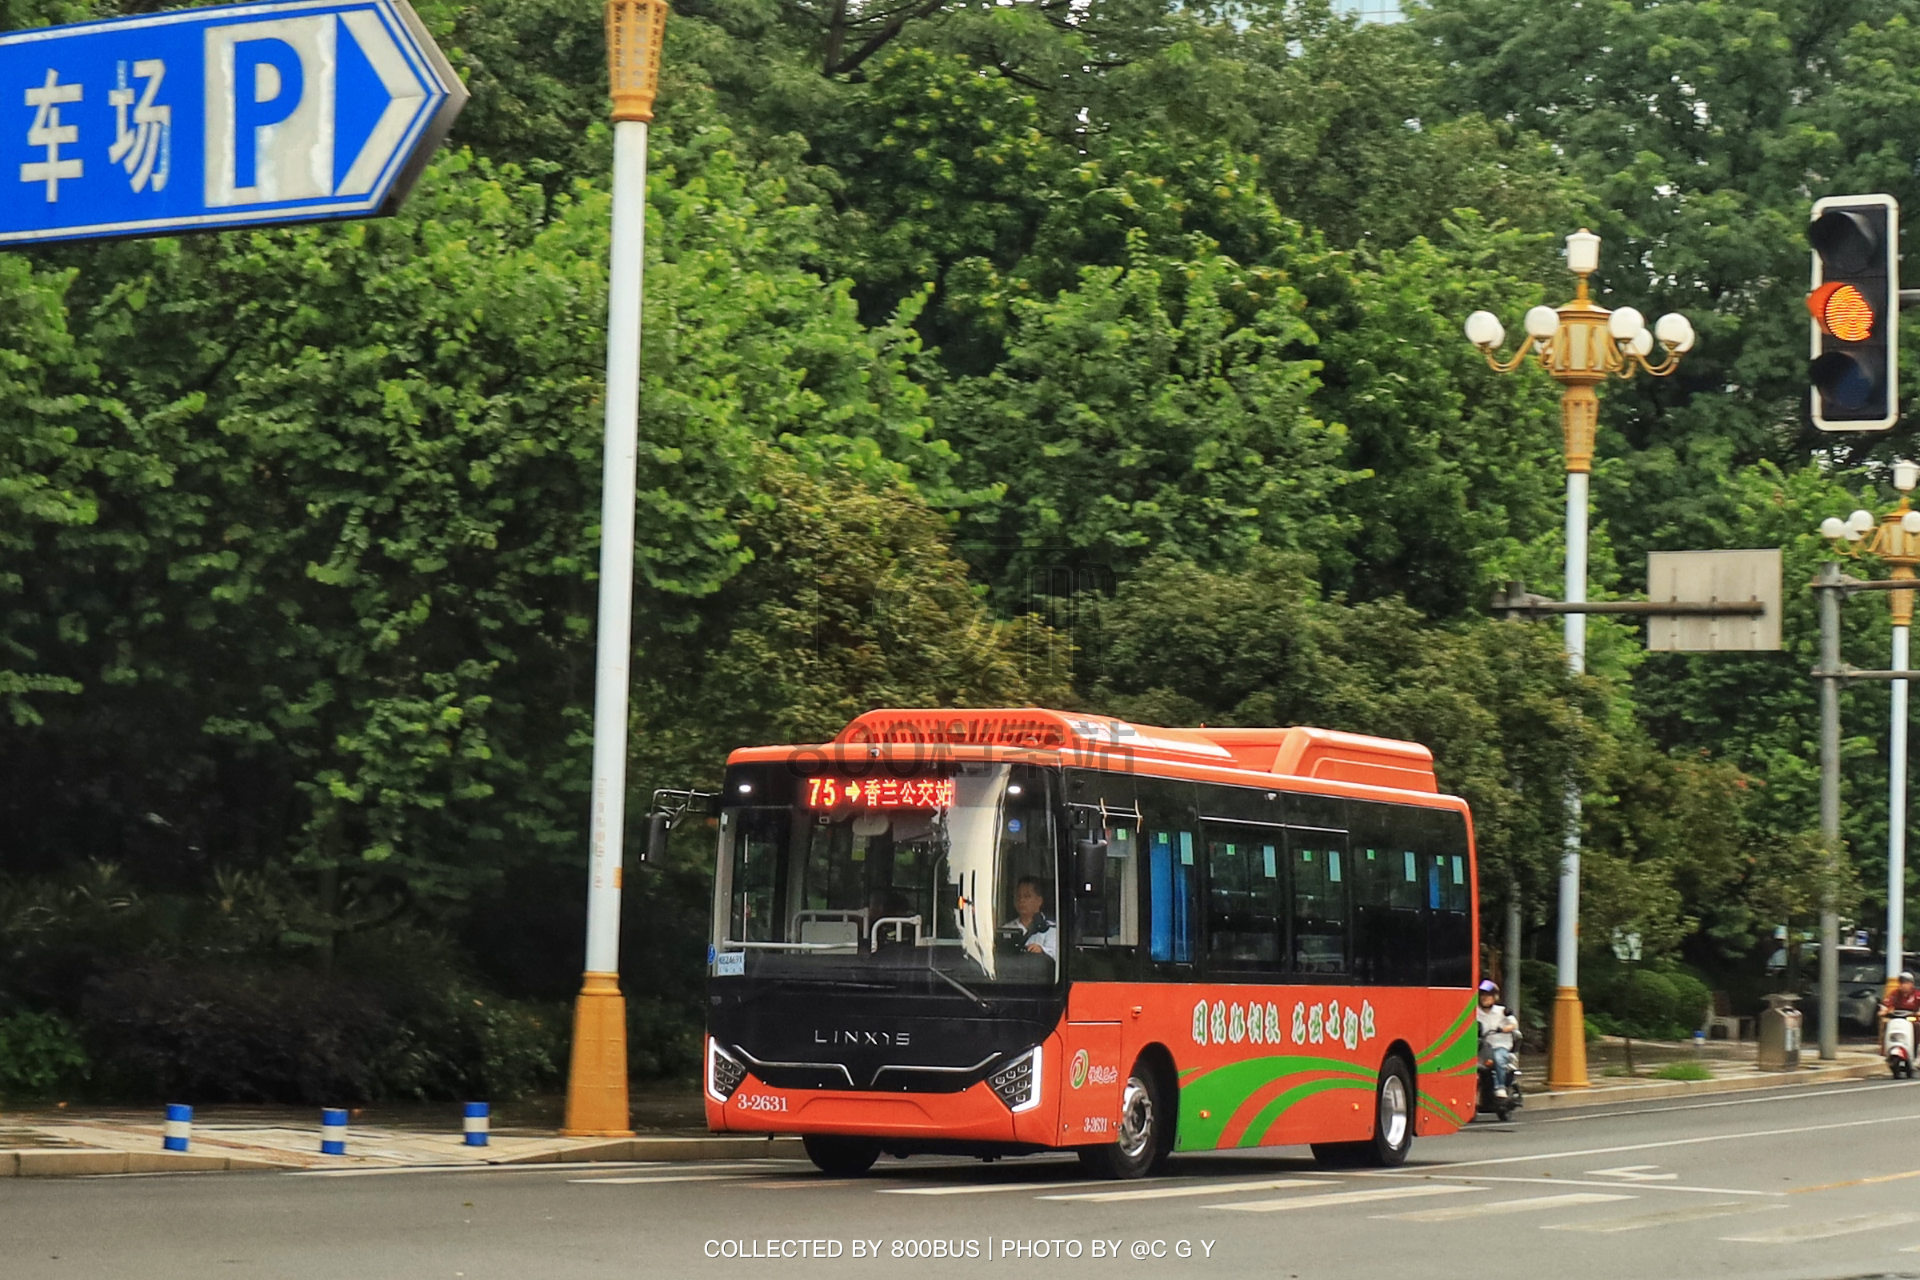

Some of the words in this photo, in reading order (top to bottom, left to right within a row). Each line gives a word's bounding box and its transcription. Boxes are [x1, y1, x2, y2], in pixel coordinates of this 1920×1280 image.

[20, 58, 171, 203] 车场
[234, 37, 305, 189] P
[808, 778, 837, 807] 75
[864, 778, 953, 807] 香兰公交站
[737, 1093, 789, 1112] 3-2631
[1083, 1117, 1108, 1133] 3-2631
